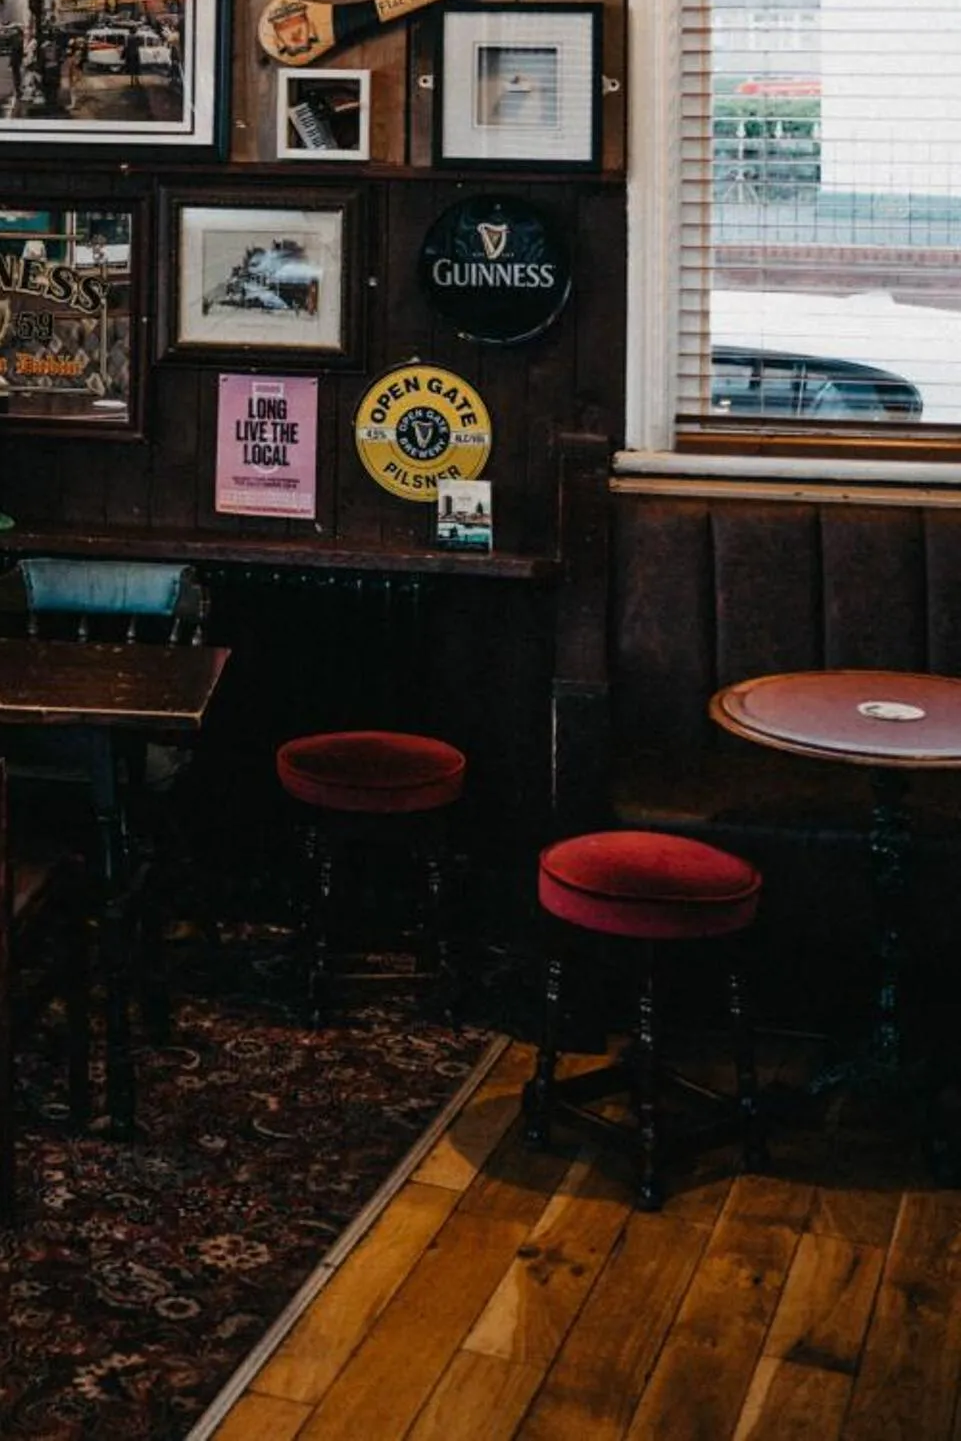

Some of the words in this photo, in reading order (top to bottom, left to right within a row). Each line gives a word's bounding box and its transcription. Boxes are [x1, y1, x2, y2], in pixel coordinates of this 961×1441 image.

[432, 257, 555, 289] GUINNESS
[14, 310, 55, 341] 59
[247, 397, 288, 420] LONG
[369, 376, 422, 424] OPEN
[426, 377, 478, 428] GATE
[235, 419, 268, 442] LIVE
[271, 422, 299, 445] THE
[243, 443, 291, 467] LOCAL
